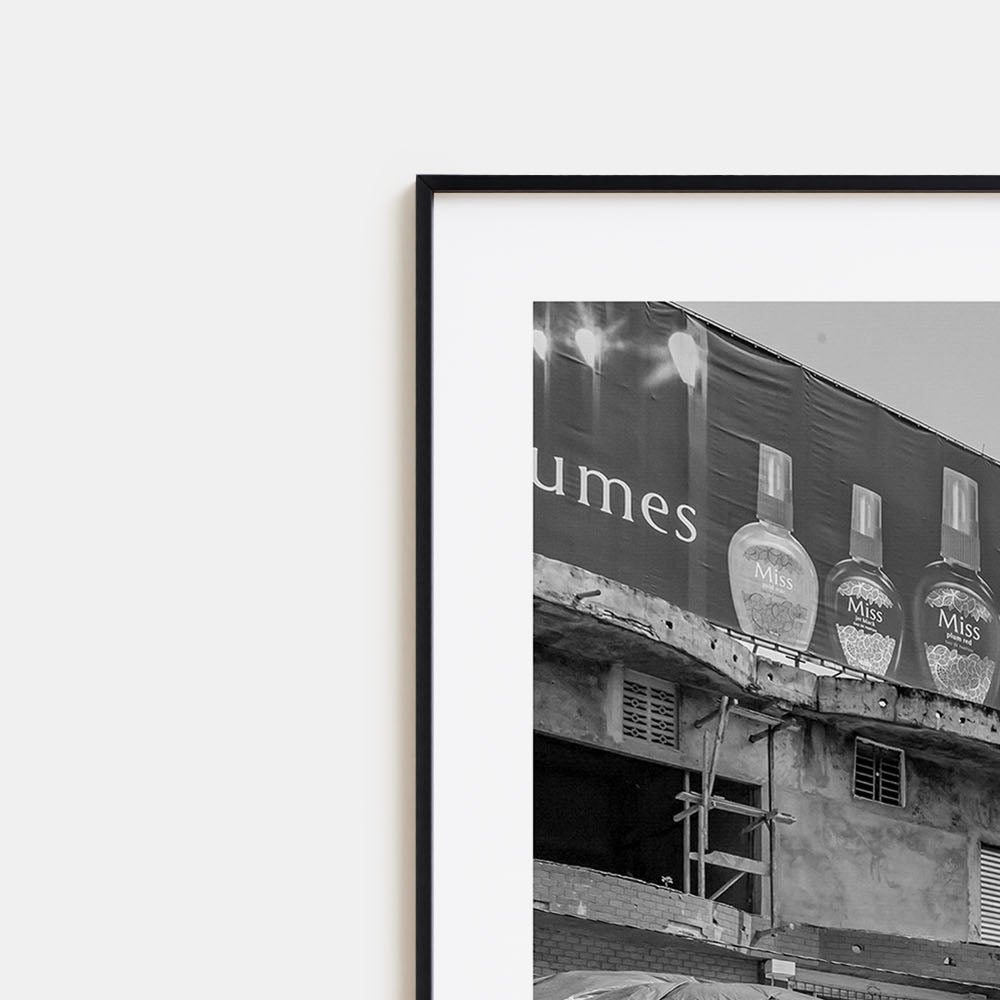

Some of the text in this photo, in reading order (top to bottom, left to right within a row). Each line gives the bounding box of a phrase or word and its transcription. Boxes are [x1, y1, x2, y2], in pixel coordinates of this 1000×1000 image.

[533, 447, 697, 543] umes
[754, 562, 793, 590] Miss
[847, 597, 884, 623] Miss
[938, 608, 981, 641] Miss
